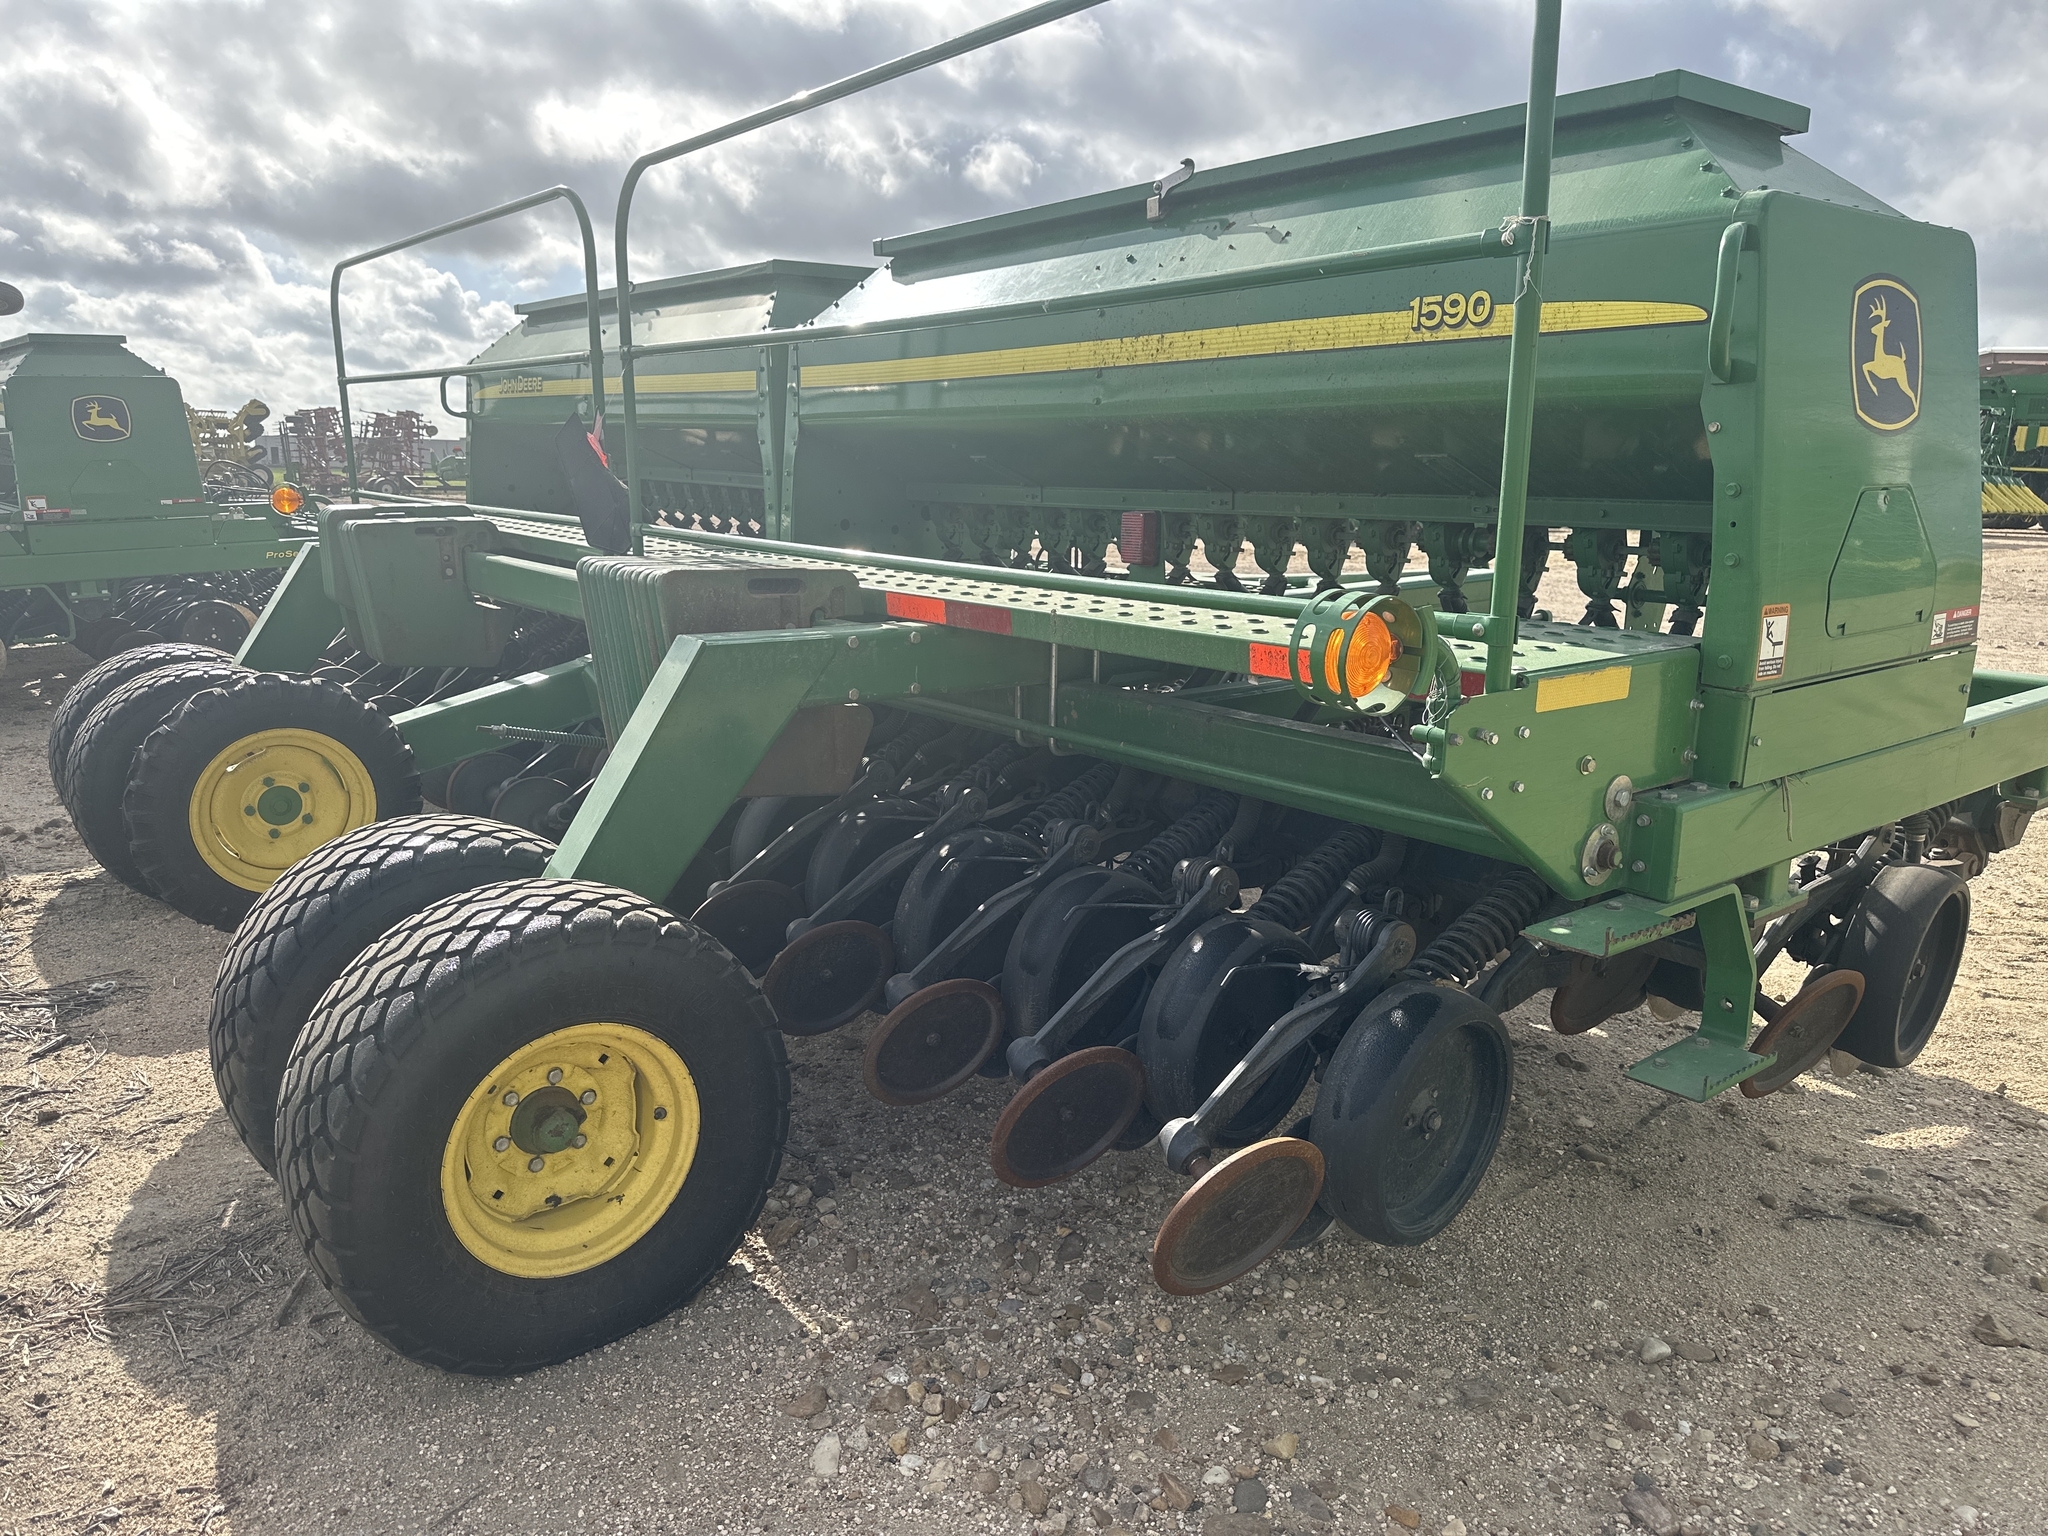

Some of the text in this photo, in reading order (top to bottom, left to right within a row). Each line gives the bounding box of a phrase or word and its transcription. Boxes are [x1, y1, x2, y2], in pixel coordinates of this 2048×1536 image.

[1409, 289, 1494, 330] 1590
[1768, 606, 1788, 614] WARNING
[1956, 608, 1972, 618] DANGER
